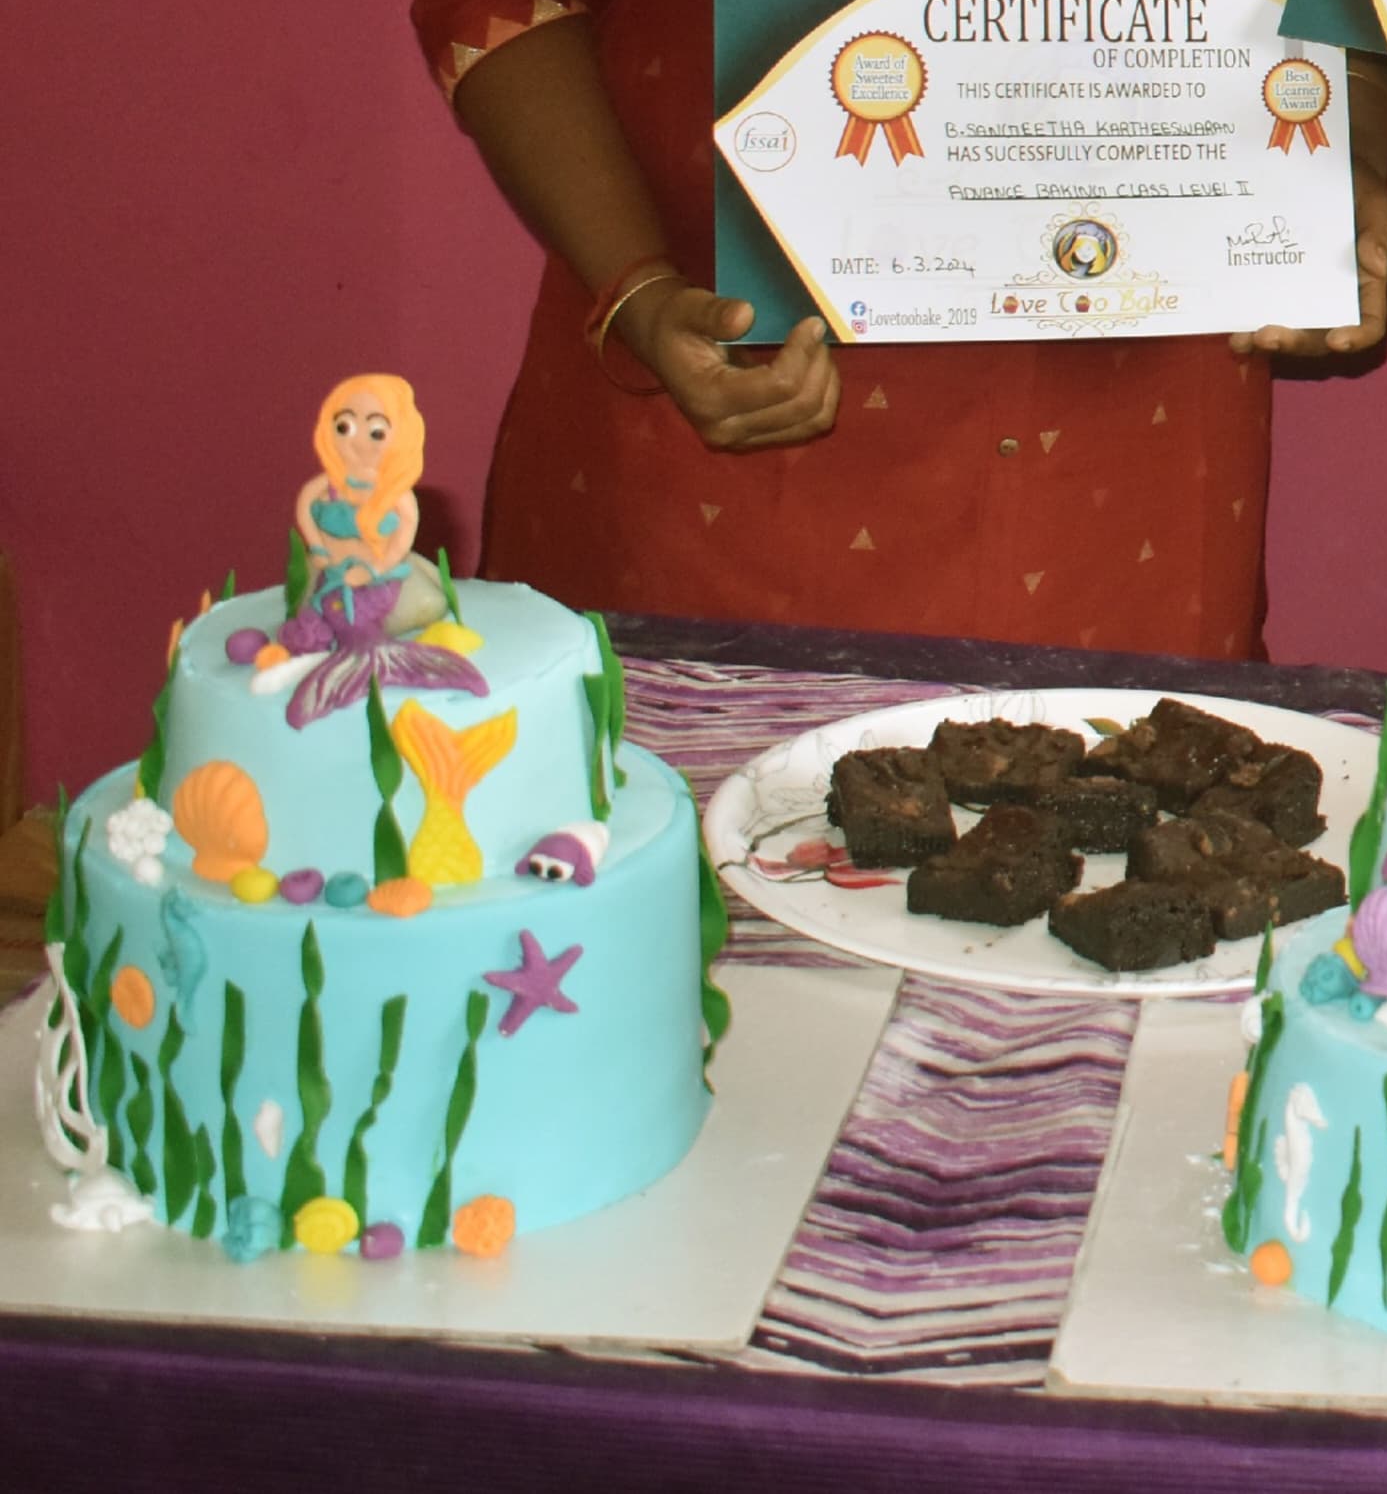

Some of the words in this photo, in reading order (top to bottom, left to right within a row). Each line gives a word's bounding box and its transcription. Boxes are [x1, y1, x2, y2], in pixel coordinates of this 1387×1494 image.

[853, 56, 891, 70] Award
[893, 54, 907, 70] of
[1092, 48, 1118, 68] OF
[1124, 47, 1251, 69] COMPLETION
[854, 70, 904, 84] Sweetest
[1285, 69, 1310, 83] Best
[851, 85, 910, 101] Excellence
[957, 82, 991, 99] THIS
[994, 82, 1087, 99] CERTIFICATE
[1089, 82, 1102, 98] IS
[1104, 82, 1182, 99] AWARDED
[1185, 82, 1206, 98] TO
[1275, 83, 1321, 97] Learner
[1279, 97, 1318, 110] Award
[740, 126, 788, 152] fssai
[947, 146, 981, 162] HAS
[984, 145, 1091, 162] SUCESSFULLY
[1096, 144, 1192, 161] COMPLETED
[1196, 144, 1227, 160] THE
[949, 184, 1023, 201] ADVANCE
[1116, 183, 1170, 198] CLASS
[1179, 181, 1231, 197] LEVEL
[831, 257, 879, 275] DATE:
[1227, 248, 1306, 267] Instructor
[1118, 291, 1178, 314] Bake
[868, 308, 978, 329] Lovetoobake_2019
